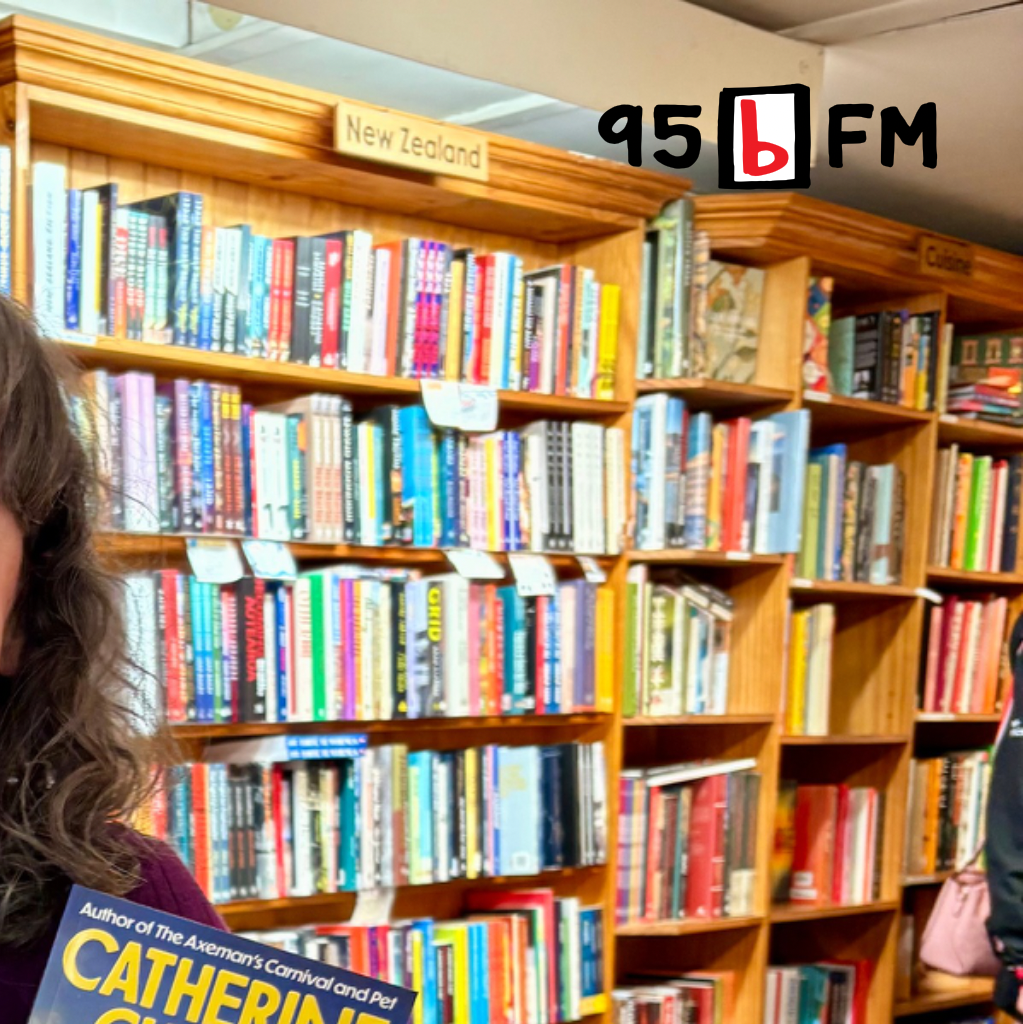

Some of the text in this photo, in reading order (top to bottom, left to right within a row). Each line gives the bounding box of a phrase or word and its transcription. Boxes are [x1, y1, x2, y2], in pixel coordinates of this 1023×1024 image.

[345, 114, 481, 170] New Zealand
[925, 245, 972, 276] Cuisine
[79, 902, 399, 1012] Author of The Axeman's Carnival and Pet
